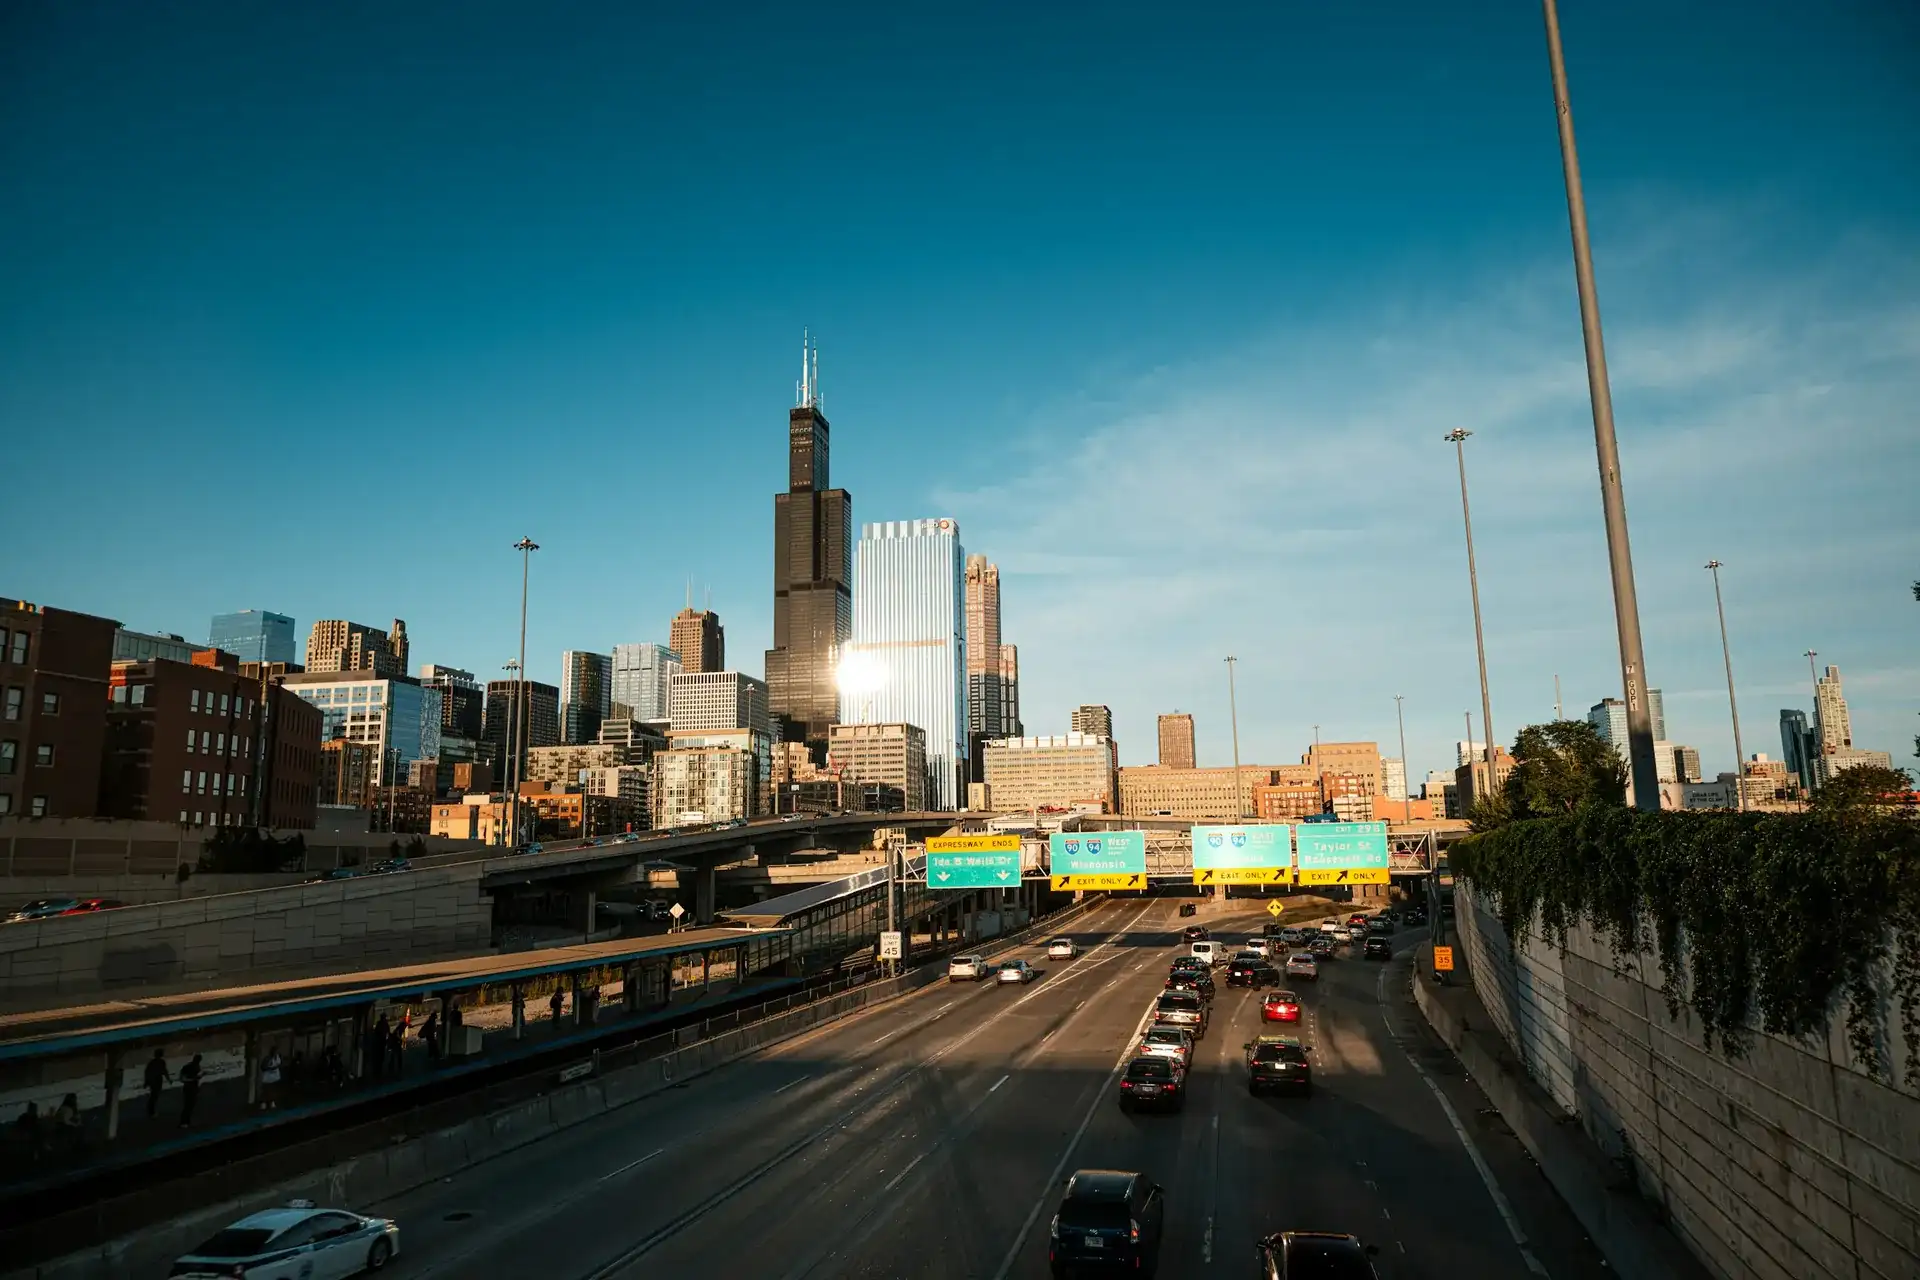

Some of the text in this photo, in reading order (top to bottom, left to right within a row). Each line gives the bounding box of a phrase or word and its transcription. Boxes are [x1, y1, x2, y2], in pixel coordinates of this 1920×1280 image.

[1627, 665, 1633, 673] 7
[933, 841, 984, 849] EXPRESSWAY
[1067, 843, 1078, 852] 90
[1088, 843, 1100, 852] 94
[1313, 841, 1371, 852] Taylor St
[1070, 860, 1126, 869] Wisconsin
[1353, 872, 1377, 880] ONLY
[884, 947, 898, 956] 45
[1438, 956, 1450, 964] 35
